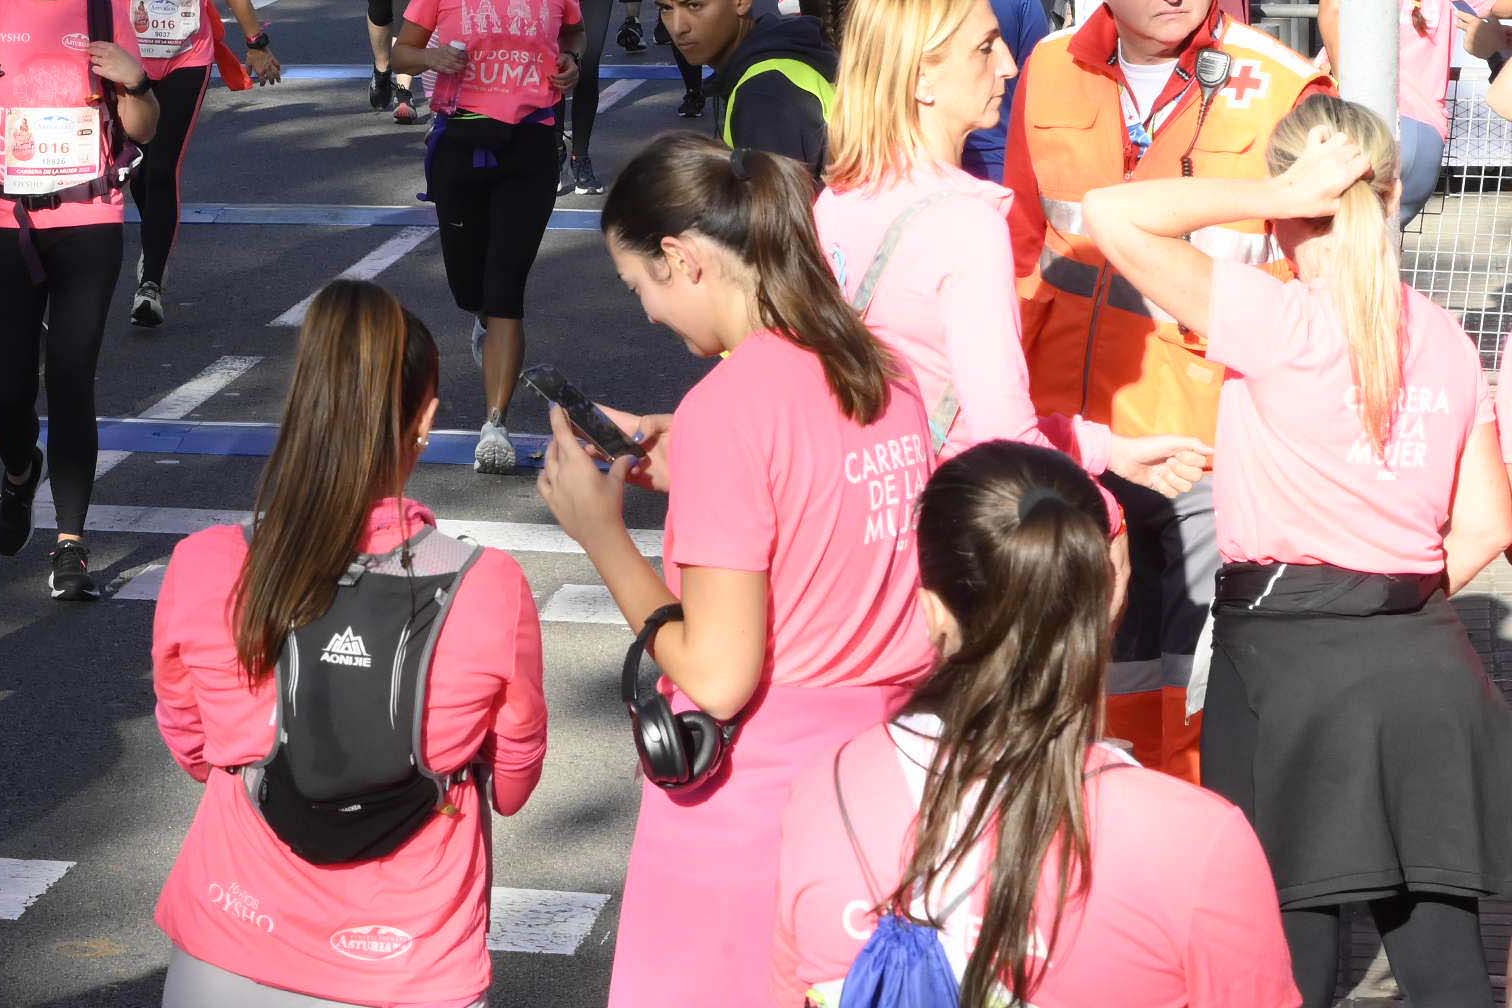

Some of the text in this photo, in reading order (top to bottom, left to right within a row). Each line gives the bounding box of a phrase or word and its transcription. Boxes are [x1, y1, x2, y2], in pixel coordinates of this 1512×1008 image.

[152, 20, 175, 29] 016
[464, 62, 540, 86] SUMA
[39, 143, 69, 153] 016
[869, 467, 925, 511] DE LA
